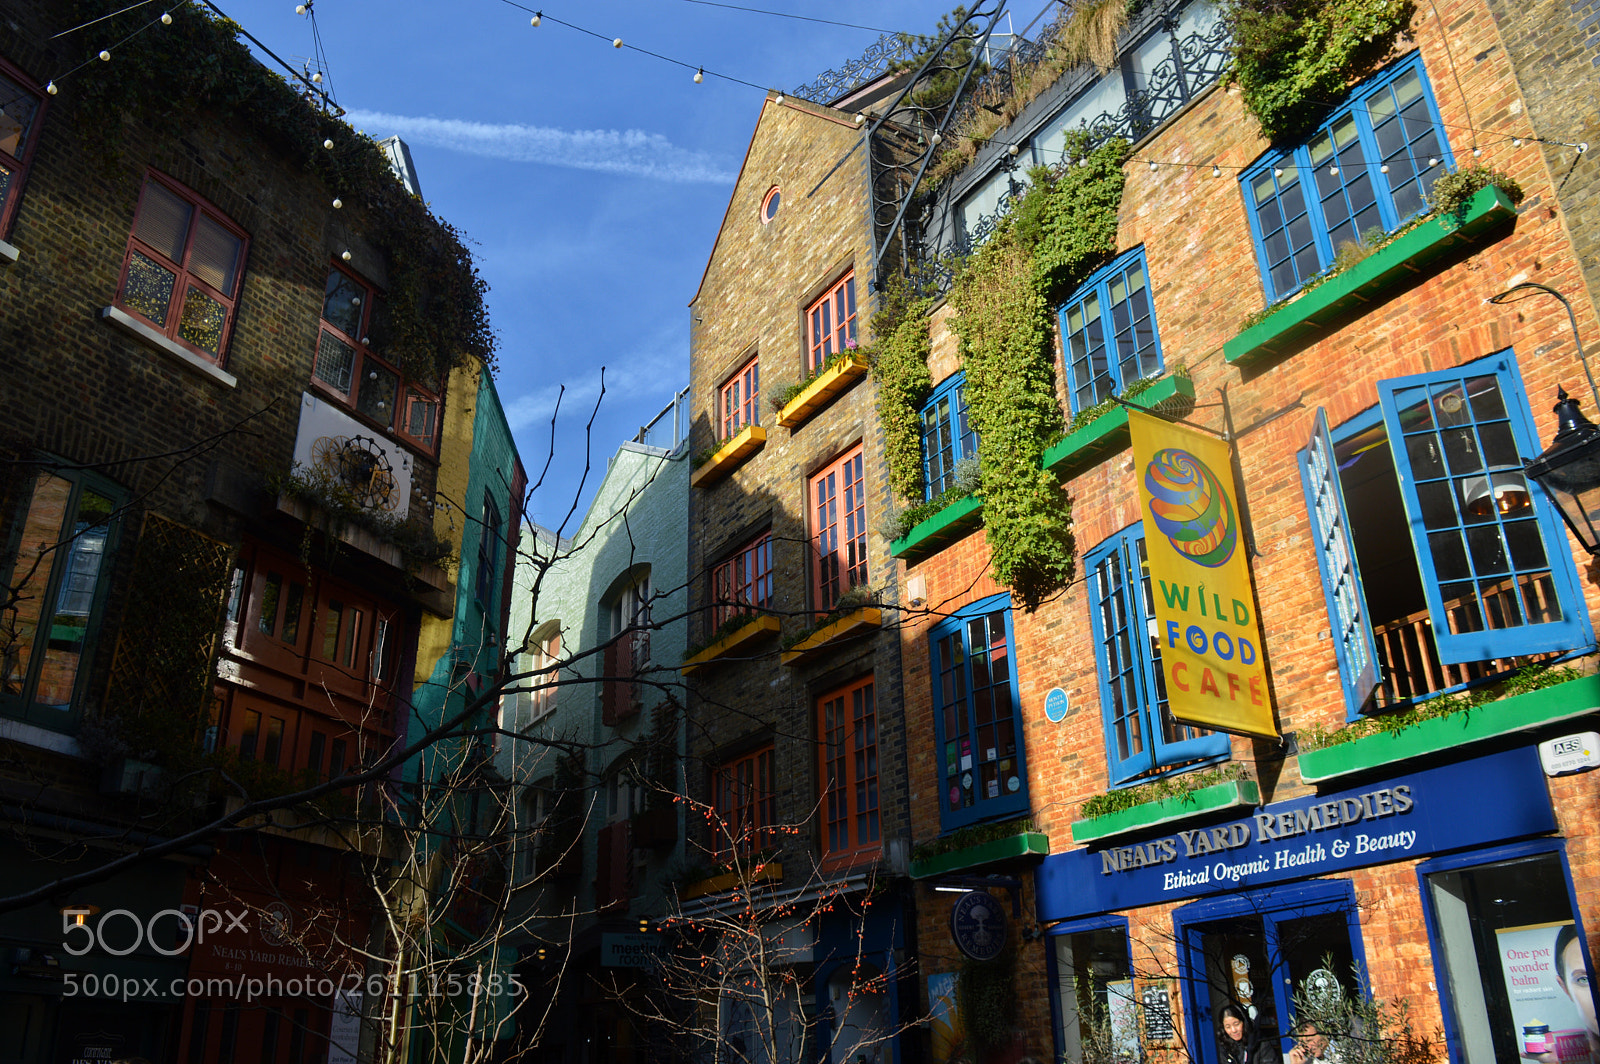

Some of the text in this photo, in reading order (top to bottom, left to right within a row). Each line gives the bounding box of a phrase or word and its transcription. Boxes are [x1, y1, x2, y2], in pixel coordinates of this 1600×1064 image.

[1159, 579, 1249, 626] WILD
[1166, 620, 1256, 665] FOOD
[1554, 739, 1580, 755] AES
[1099, 785, 1414, 874] NEAL'S YARD REMEDIES
[1163, 830, 1416, 890] Ethical Organic Health & Beauty
[212, 945, 247, 960] NEAL'S
[249, 949, 276, 964] YARD
[612, 942, 666, 957] meeting
[1507, 948, 1551, 960] One pot
[1509, 961, 1549, 973] wonder
[1511, 975, 1540, 986] balm
